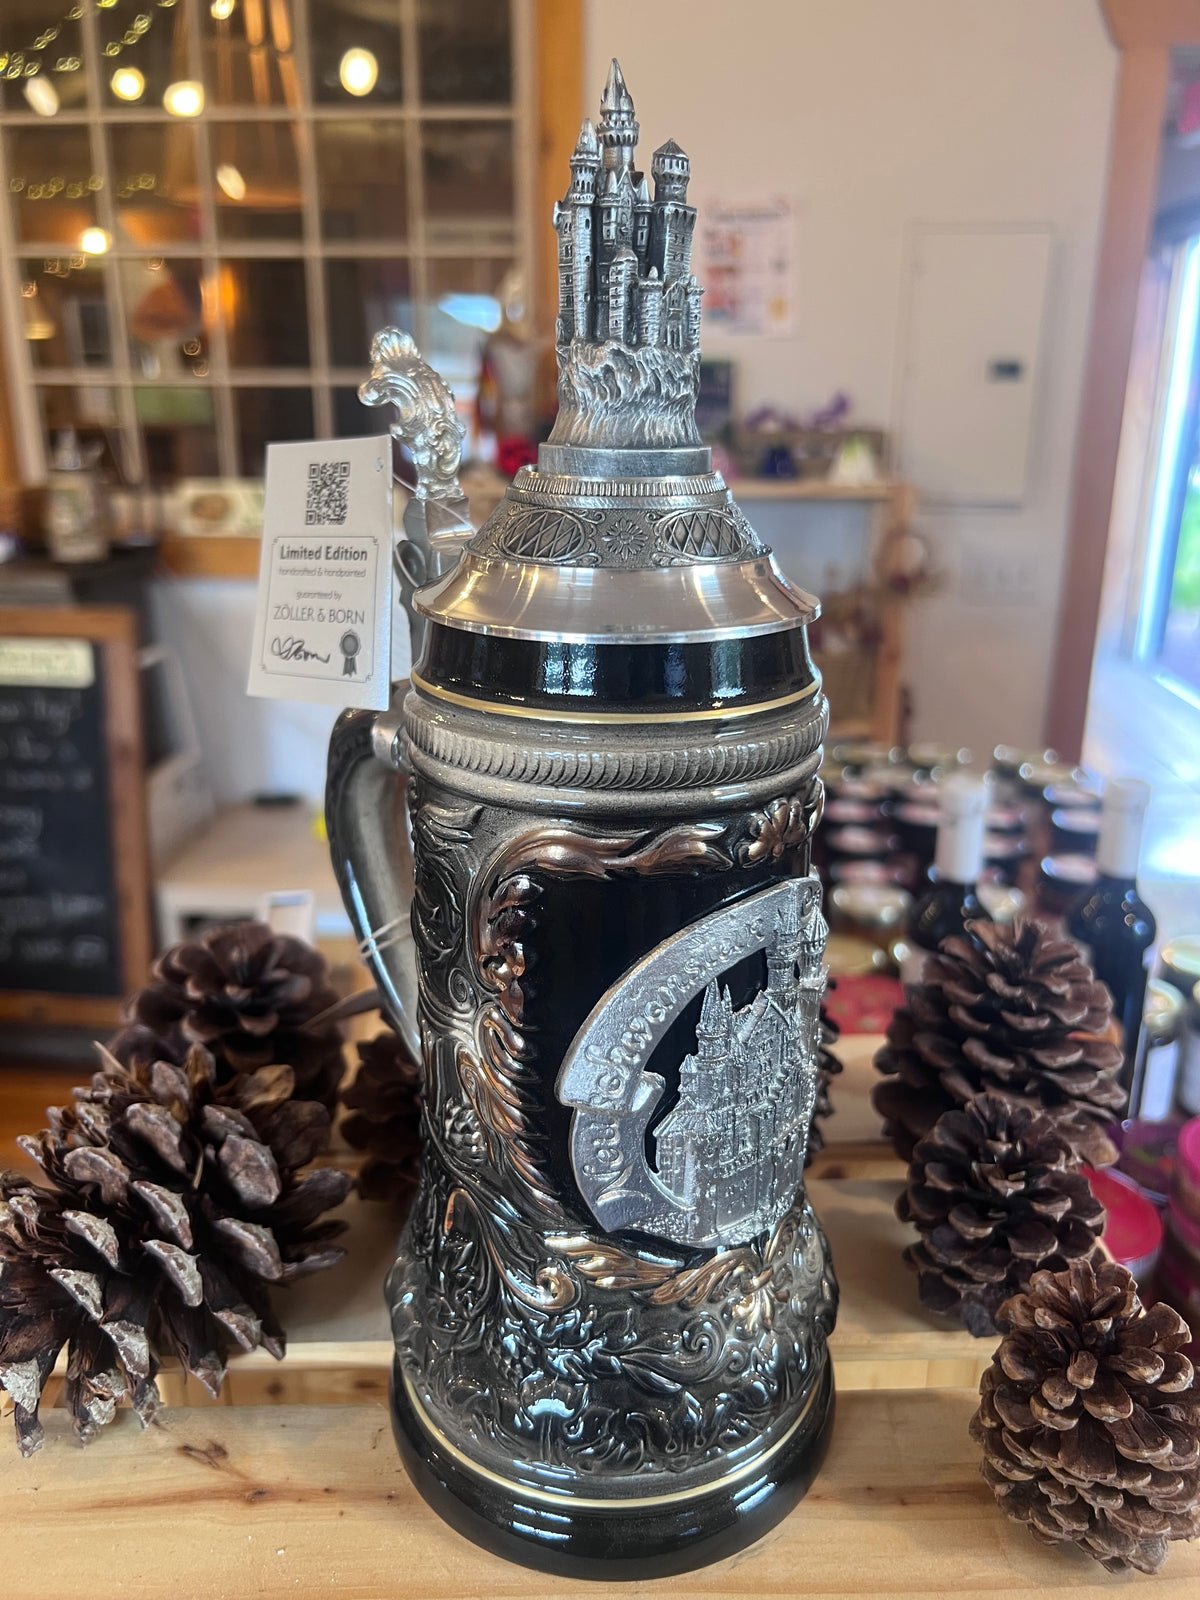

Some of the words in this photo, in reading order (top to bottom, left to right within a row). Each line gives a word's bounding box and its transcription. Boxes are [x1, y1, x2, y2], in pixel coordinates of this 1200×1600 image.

[280, 545, 321, 560] Limited
[325, 546, 368, 561] Edition
[317, 608, 325, 623] &
[328, 609, 365, 625] BORN
